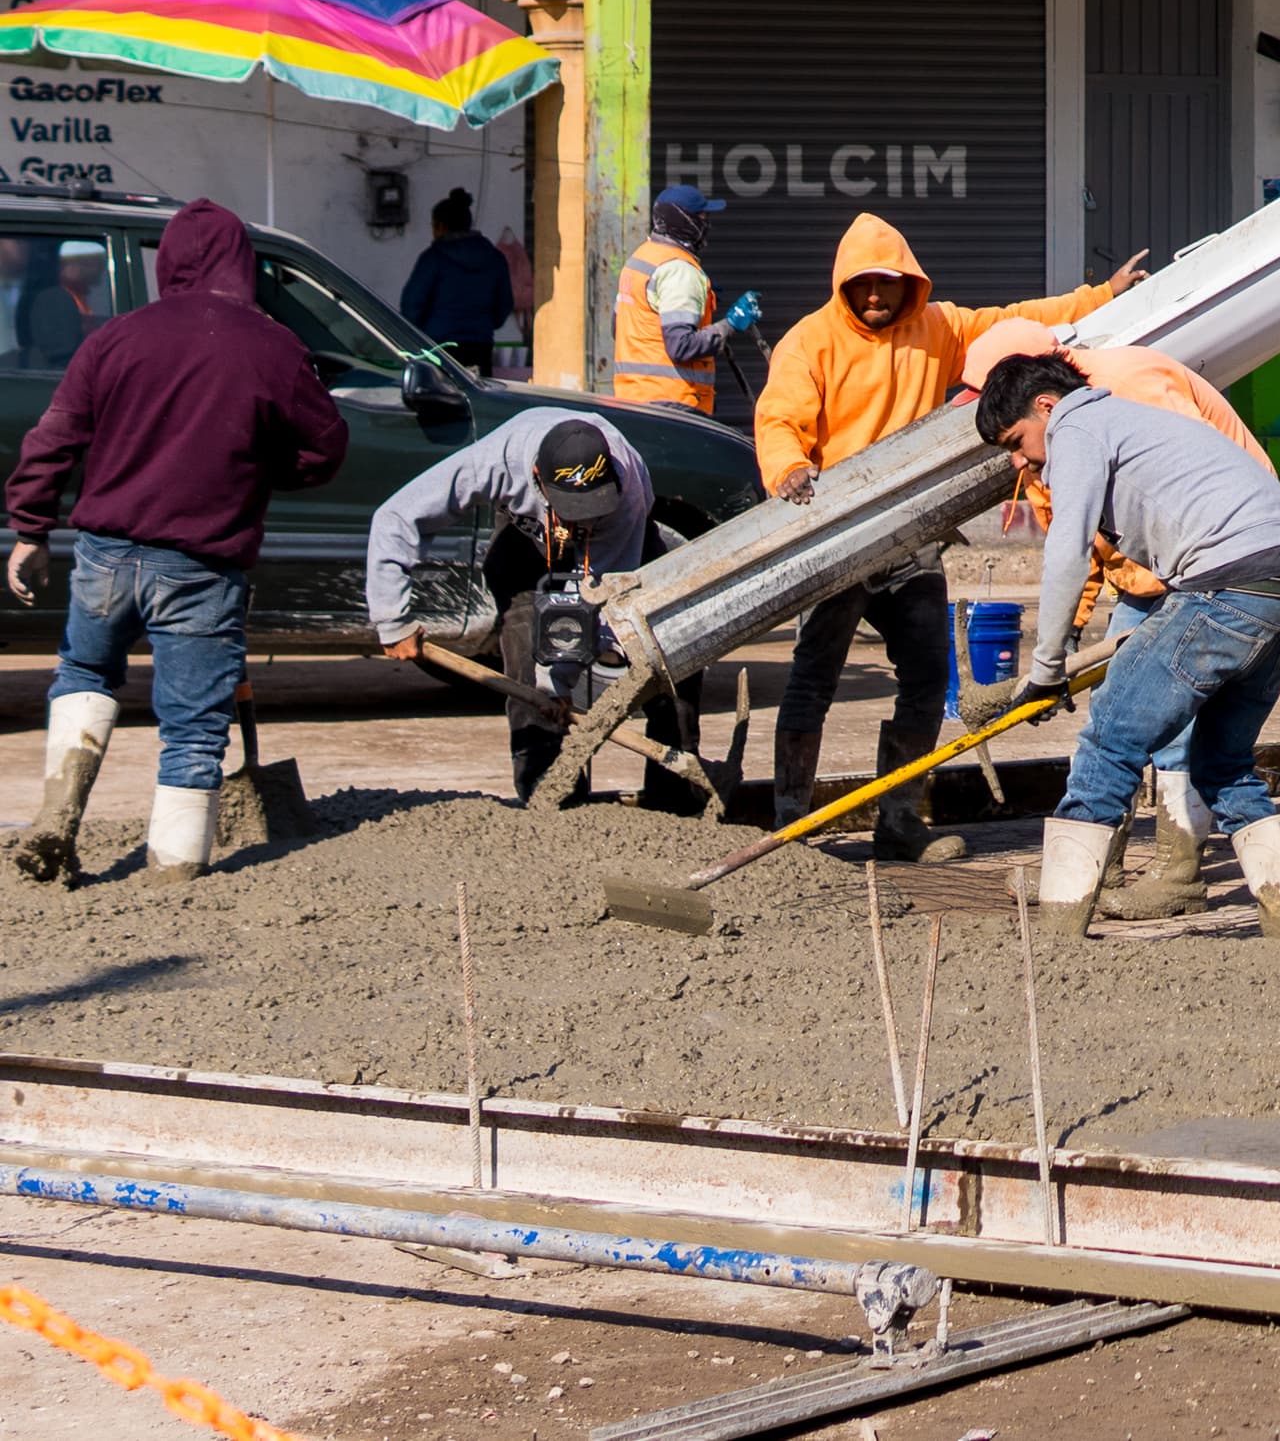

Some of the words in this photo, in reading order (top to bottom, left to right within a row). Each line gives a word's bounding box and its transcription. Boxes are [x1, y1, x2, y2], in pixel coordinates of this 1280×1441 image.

[9, 76, 164, 104] GacoFlex
[10, 117, 112, 143] Varilla
[20, 156, 113, 184] Grava
[665, 142, 968, 198] HOLCIM
